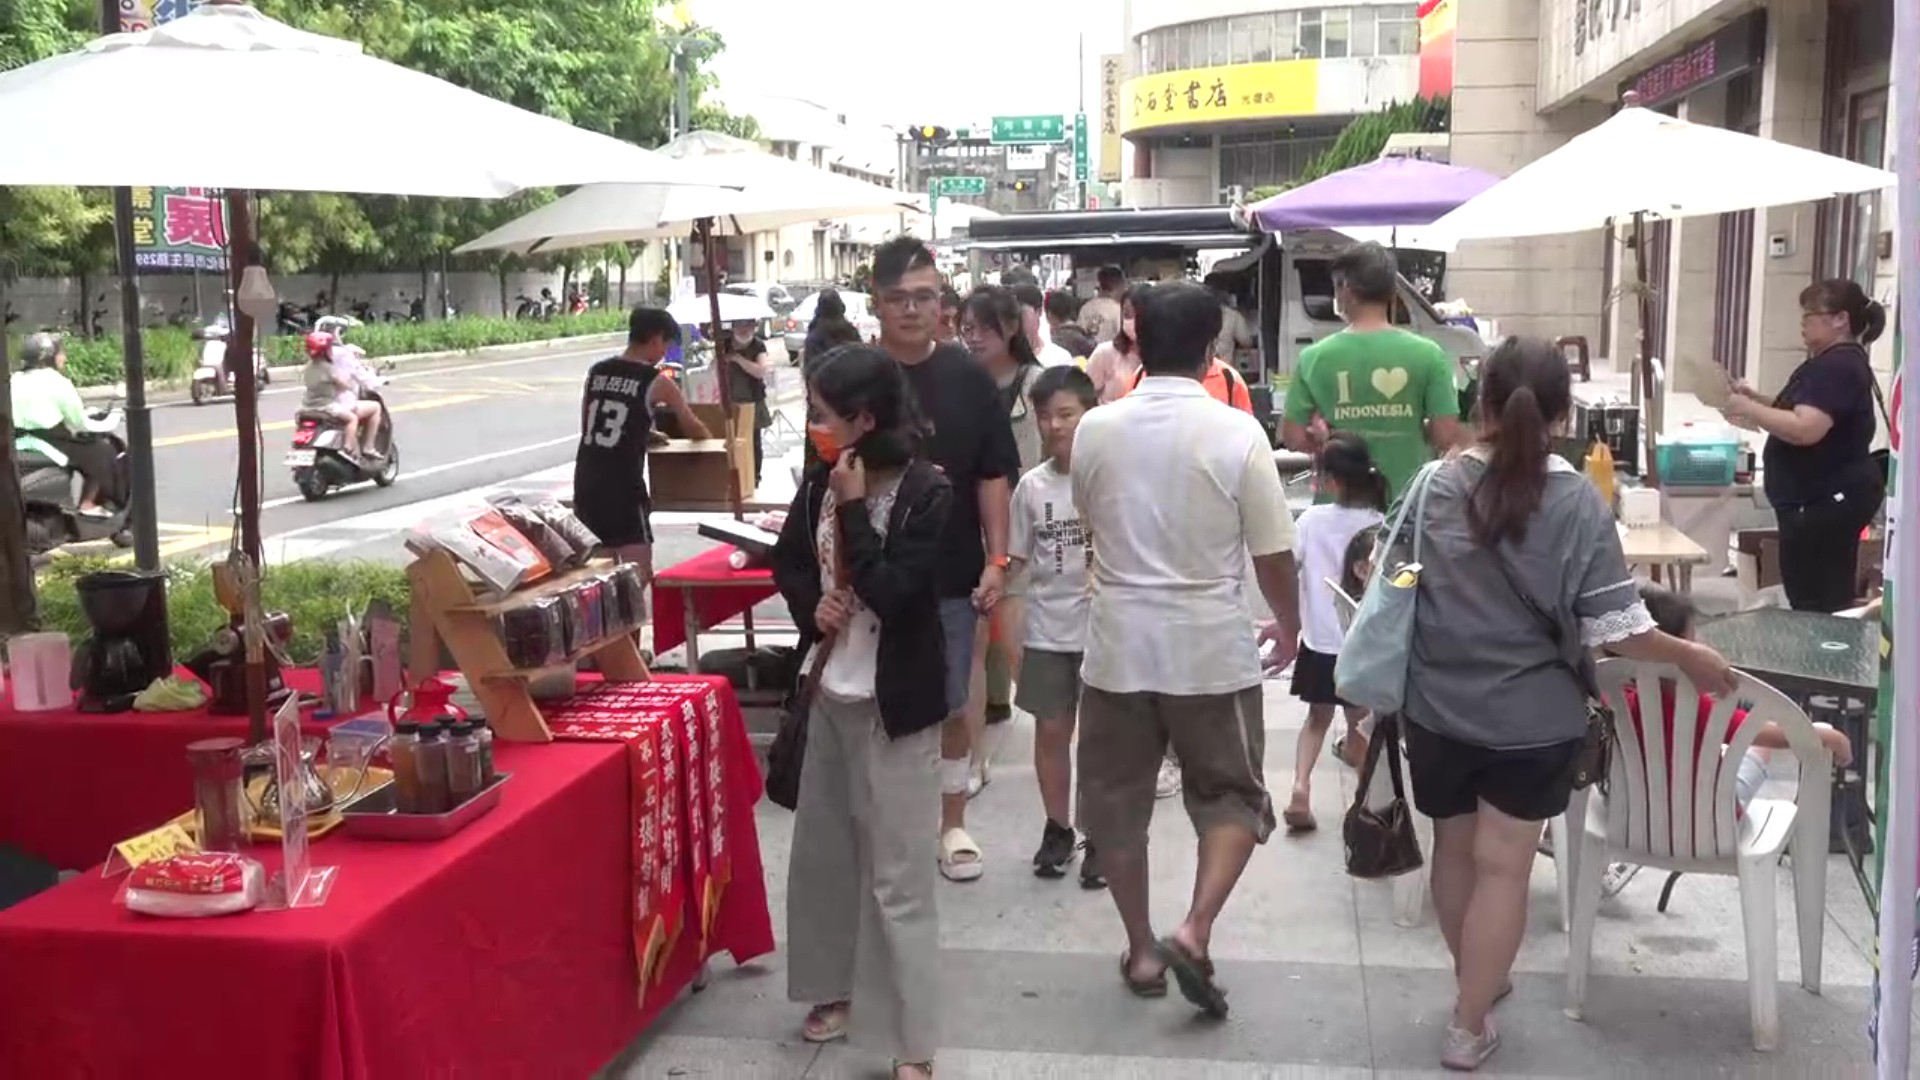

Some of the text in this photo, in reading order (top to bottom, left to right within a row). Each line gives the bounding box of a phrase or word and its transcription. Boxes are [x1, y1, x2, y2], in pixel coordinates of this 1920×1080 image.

[1134, 77, 1227, 117] 金石堂書店
[1337, 371, 1351, 404] I
[583, 399, 629, 448] 13
[1334, 403, 1414, 420] INDONESIA
